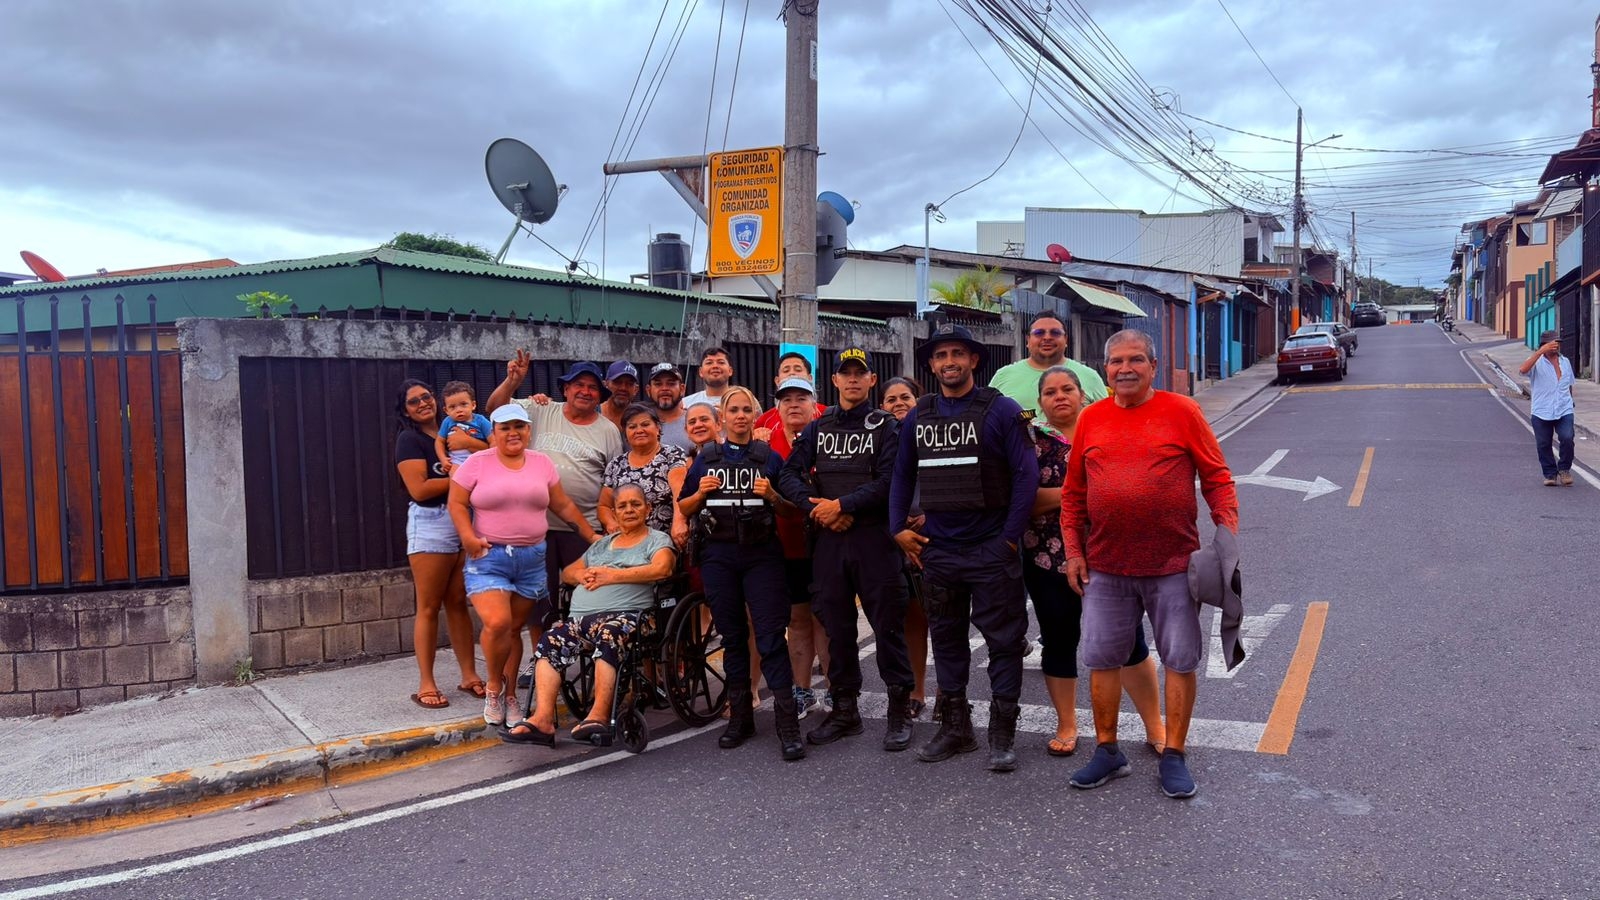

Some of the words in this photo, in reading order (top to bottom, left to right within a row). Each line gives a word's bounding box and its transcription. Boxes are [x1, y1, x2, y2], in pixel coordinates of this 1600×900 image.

[721, 152, 769, 166] SEGURIDAD
[716, 164, 774, 177] COMUNITARIA
[743, 176, 777, 186] PREVENTIVOS
[722, 188, 768, 202] COMUNIDAD
[720, 202, 769, 213] ORGANIZADA
[734, 258, 775, 266] VECINOS
[840, 348, 866, 361] POLICIA
[916, 421, 978, 447] POLICIA
[817, 432, 874, 454] POLICIA
